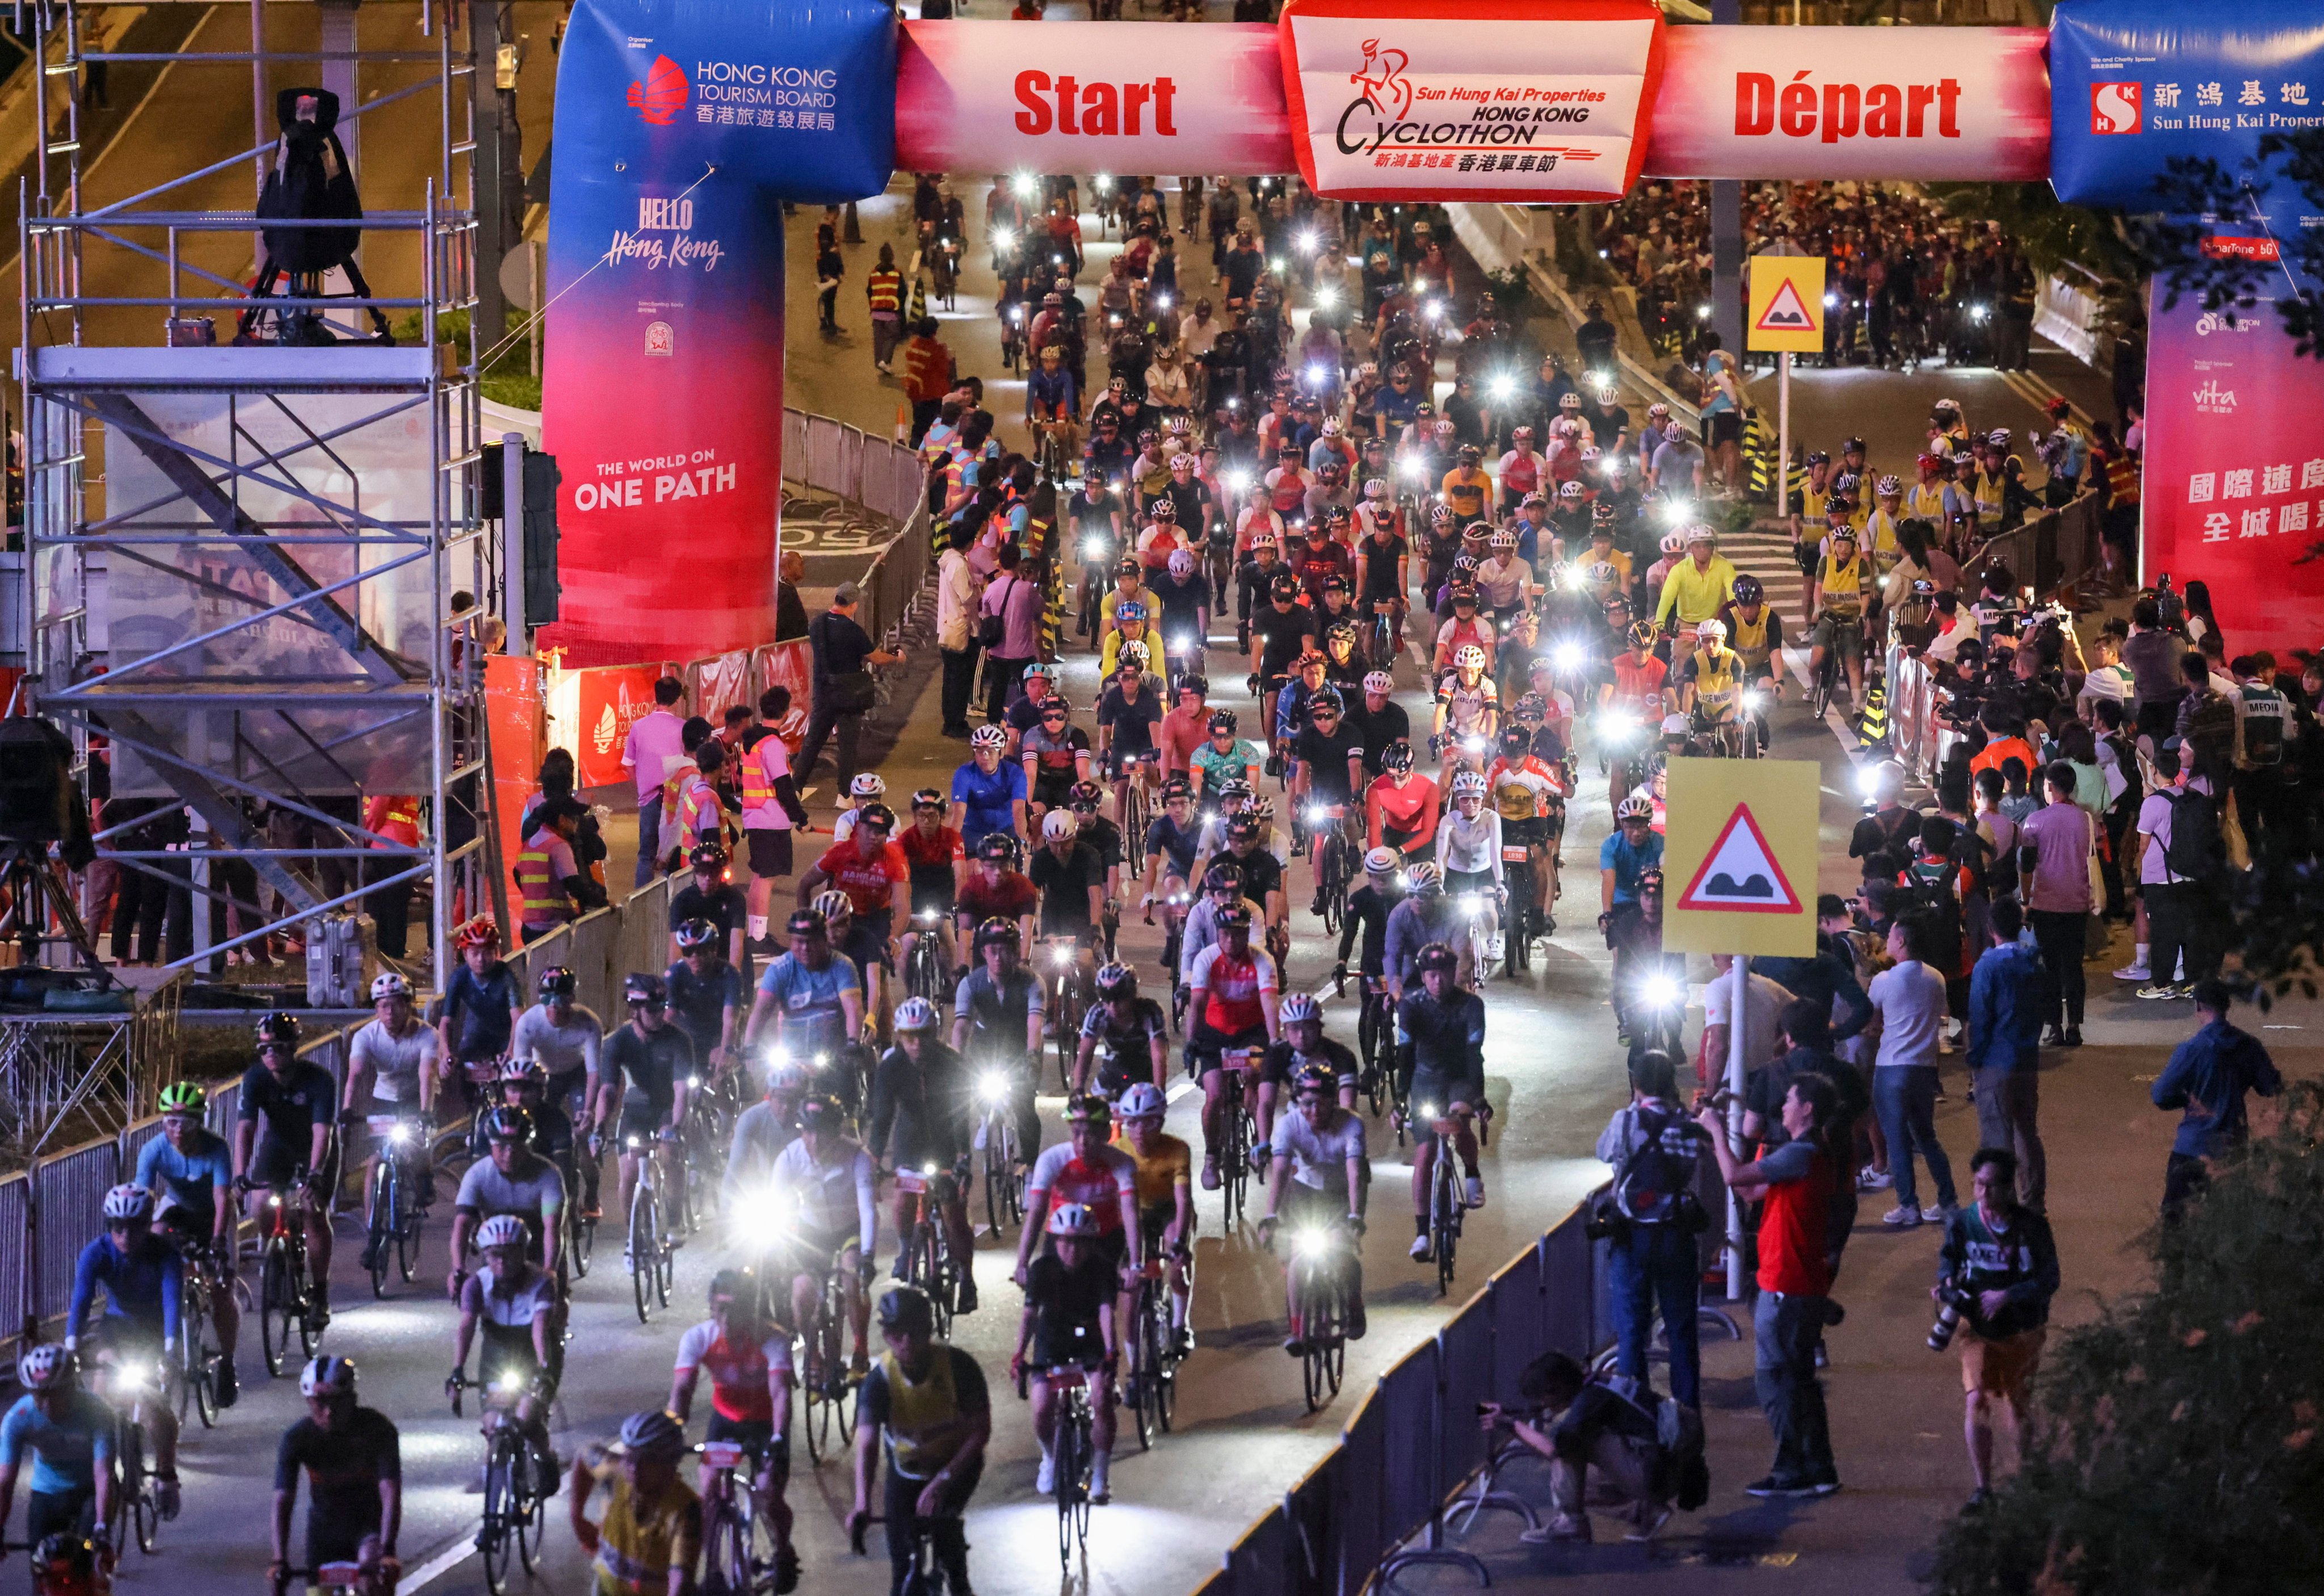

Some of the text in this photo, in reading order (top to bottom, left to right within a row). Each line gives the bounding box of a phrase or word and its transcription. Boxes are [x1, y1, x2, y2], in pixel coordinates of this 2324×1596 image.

[697, 61, 837, 89] HONG KONG
[697, 84, 836, 108] TOURISM BOARD
[1014, 69, 1177, 136] Start
[1415, 86, 1606, 104] Sun Hung Kai Properties
[1734, 70, 1961, 143] Départ
[2153, 79, 2324, 108] 新鴻基地
[696, 104, 835, 131] 香港旅遊發展局
[1336, 98, 1539, 156] CYCLOTHON
[1472, 106, 1590, 123] HONG KONG
[2153, 115, 2183, 130] Sun
[2189, 115, 2231, 132] Hung
[2237, 113, 2264, 128] Kai
[1374, 153, 1559, 173] 新鴻基地產 香港單車節
[638, 198, 693, 230] HELLO
[602, 229, 725, 272] Hong Kong
[2192, 379, 2238, 406] vita
[596, 448, 715, 476] THE WORLD ON
[574, 463, 736, 511] ONE PATH
[619, 704, 636, 719] HONG
[1699, 694, 1713, 702] RACE
[2249, 703, 2279, 713] MEDIA
[842, 870, 886, 883] BAHRAIN
